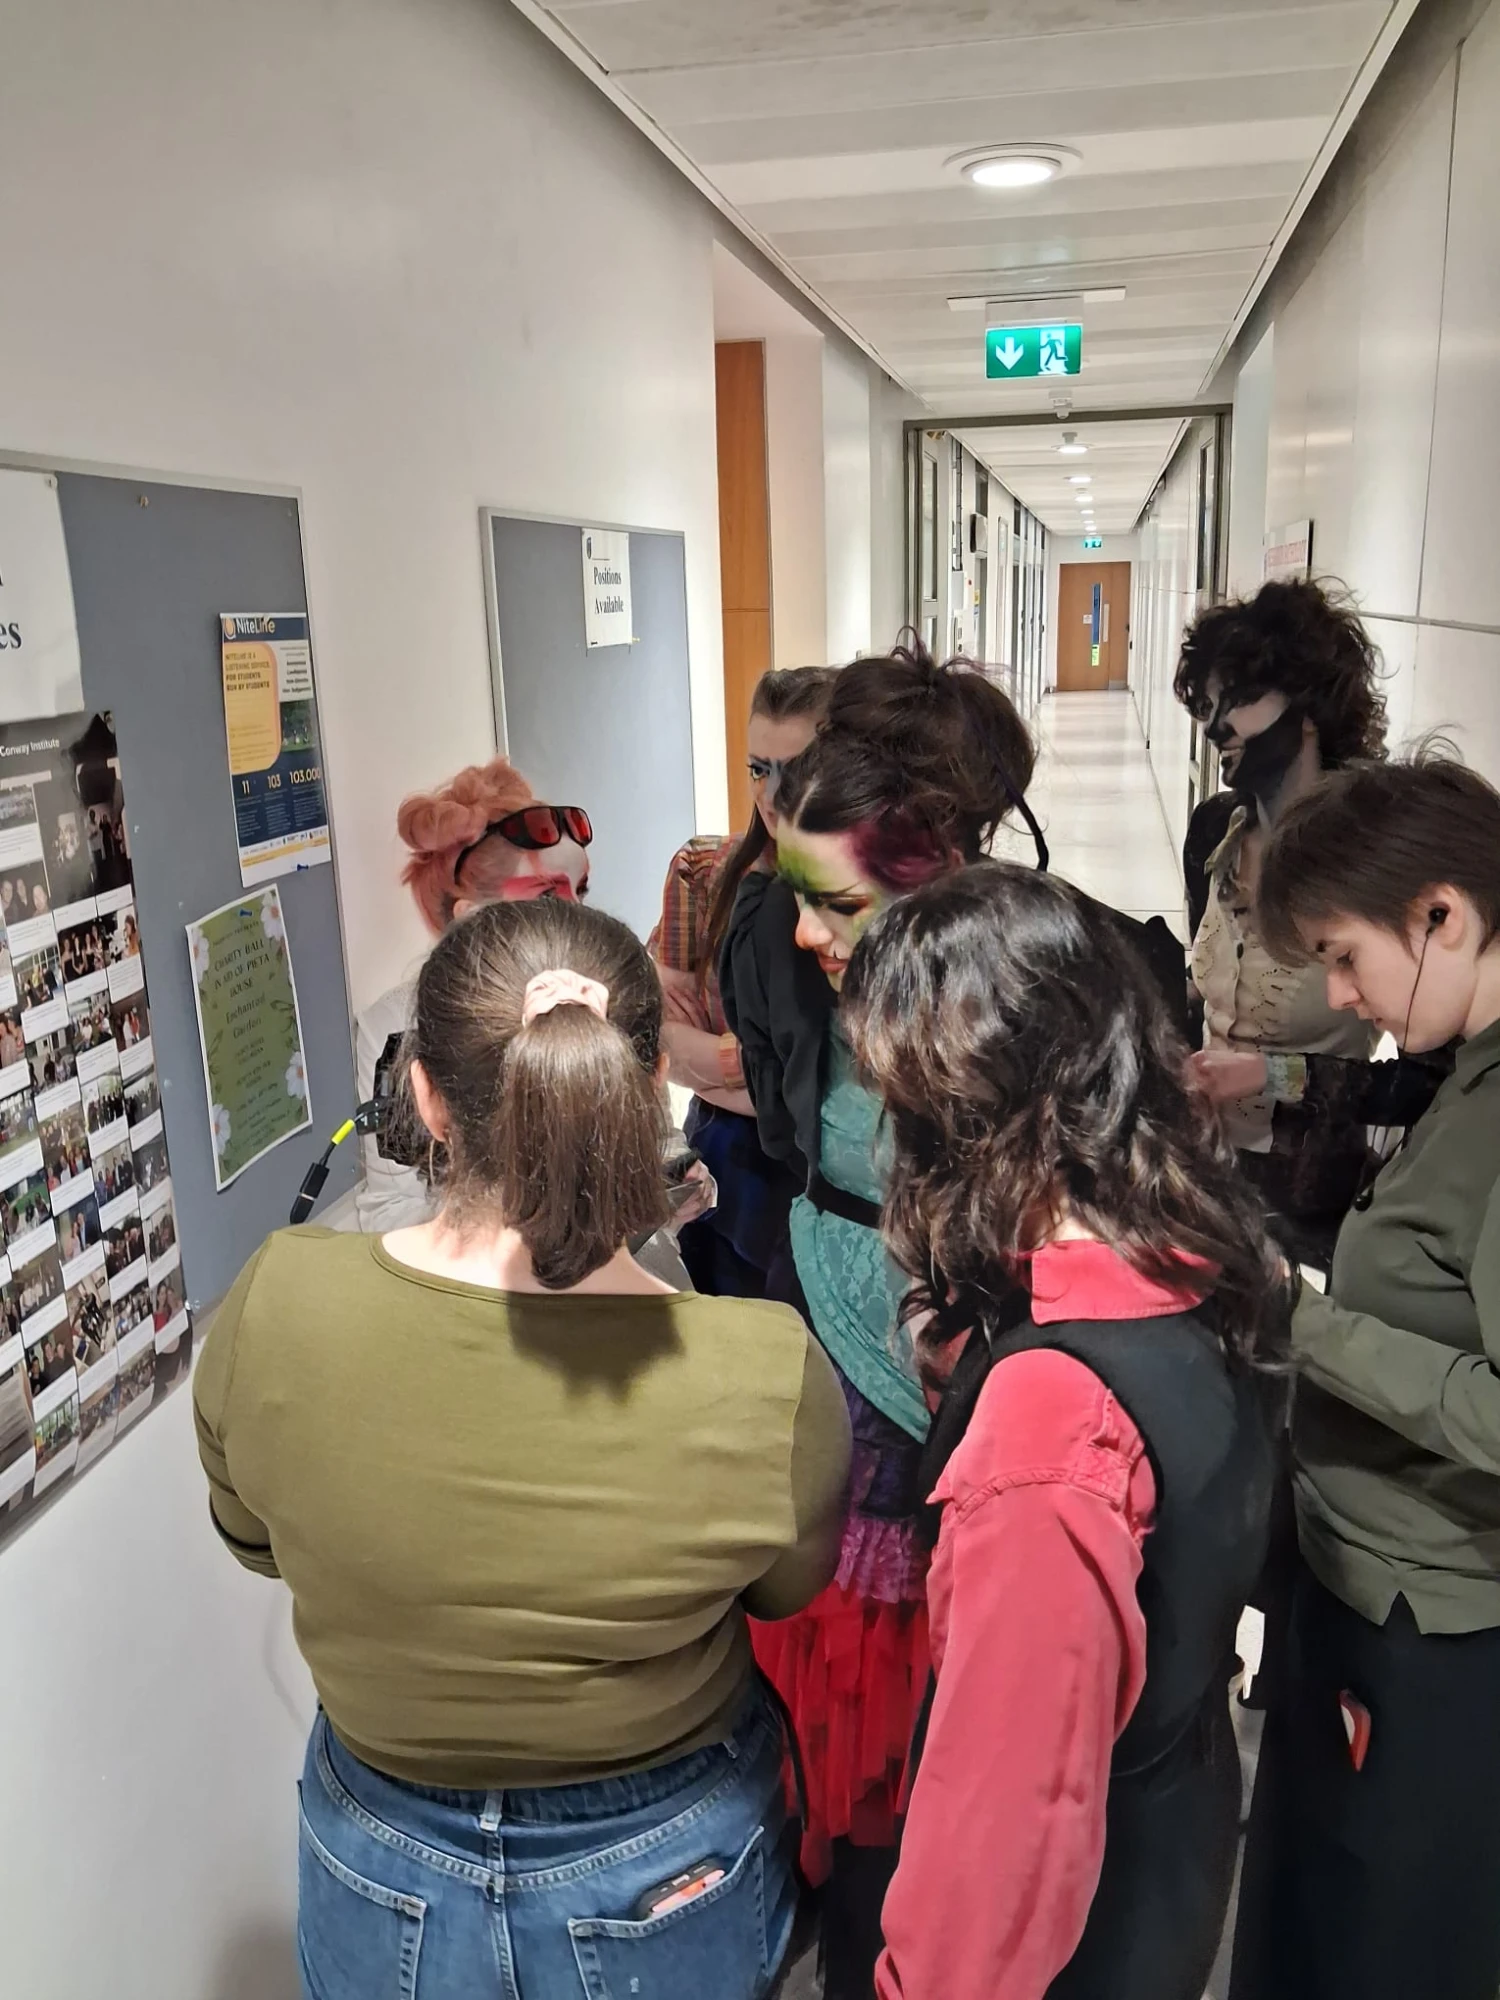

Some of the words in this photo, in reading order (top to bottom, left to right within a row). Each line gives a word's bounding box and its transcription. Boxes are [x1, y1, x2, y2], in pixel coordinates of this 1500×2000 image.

[593, 567, 622, 585] Positions
[594, 596, 624, 614] Available
[0, 745, 30, 757] Conway
[30, 738, 60, 751] Institute
[242, 780, 250, 795] 11
[267, 774, 282, 789] 103
